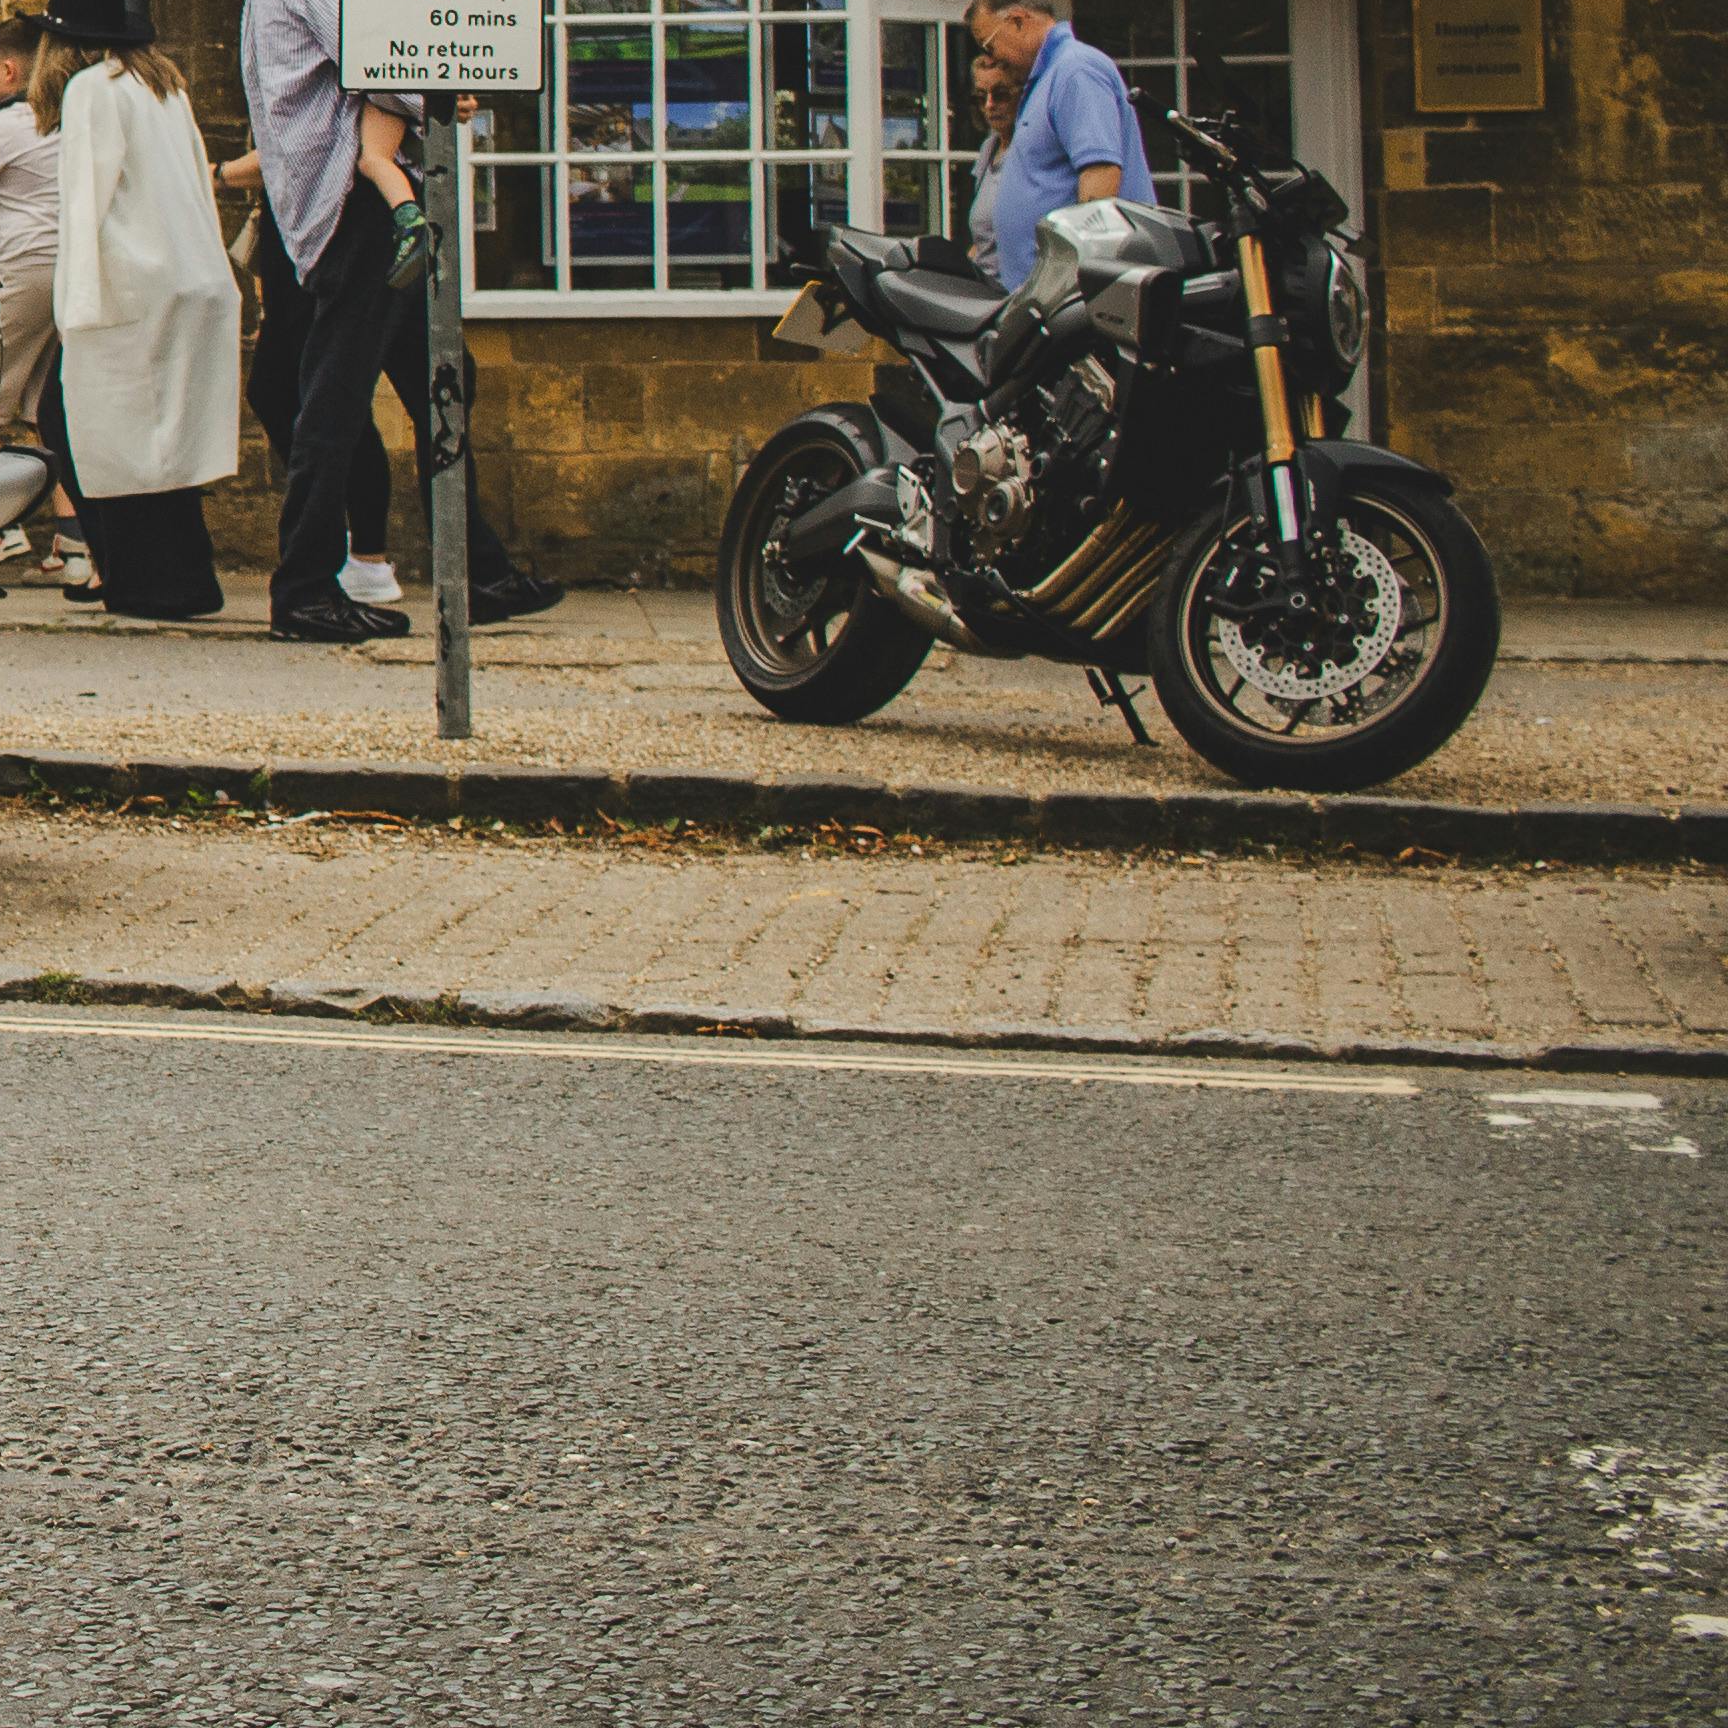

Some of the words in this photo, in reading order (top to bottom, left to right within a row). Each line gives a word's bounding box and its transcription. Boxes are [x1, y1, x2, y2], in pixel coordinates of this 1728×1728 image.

[430, 10, 459, 26] 60
[468, 10, 517, 26] mins
[389, 40, 418, 57] No
[428, 42, 494, 57] return
[364, 63, 428, 79] within
[437, 63, 450, 79] 2
[459, 63, 519, 80] hours
